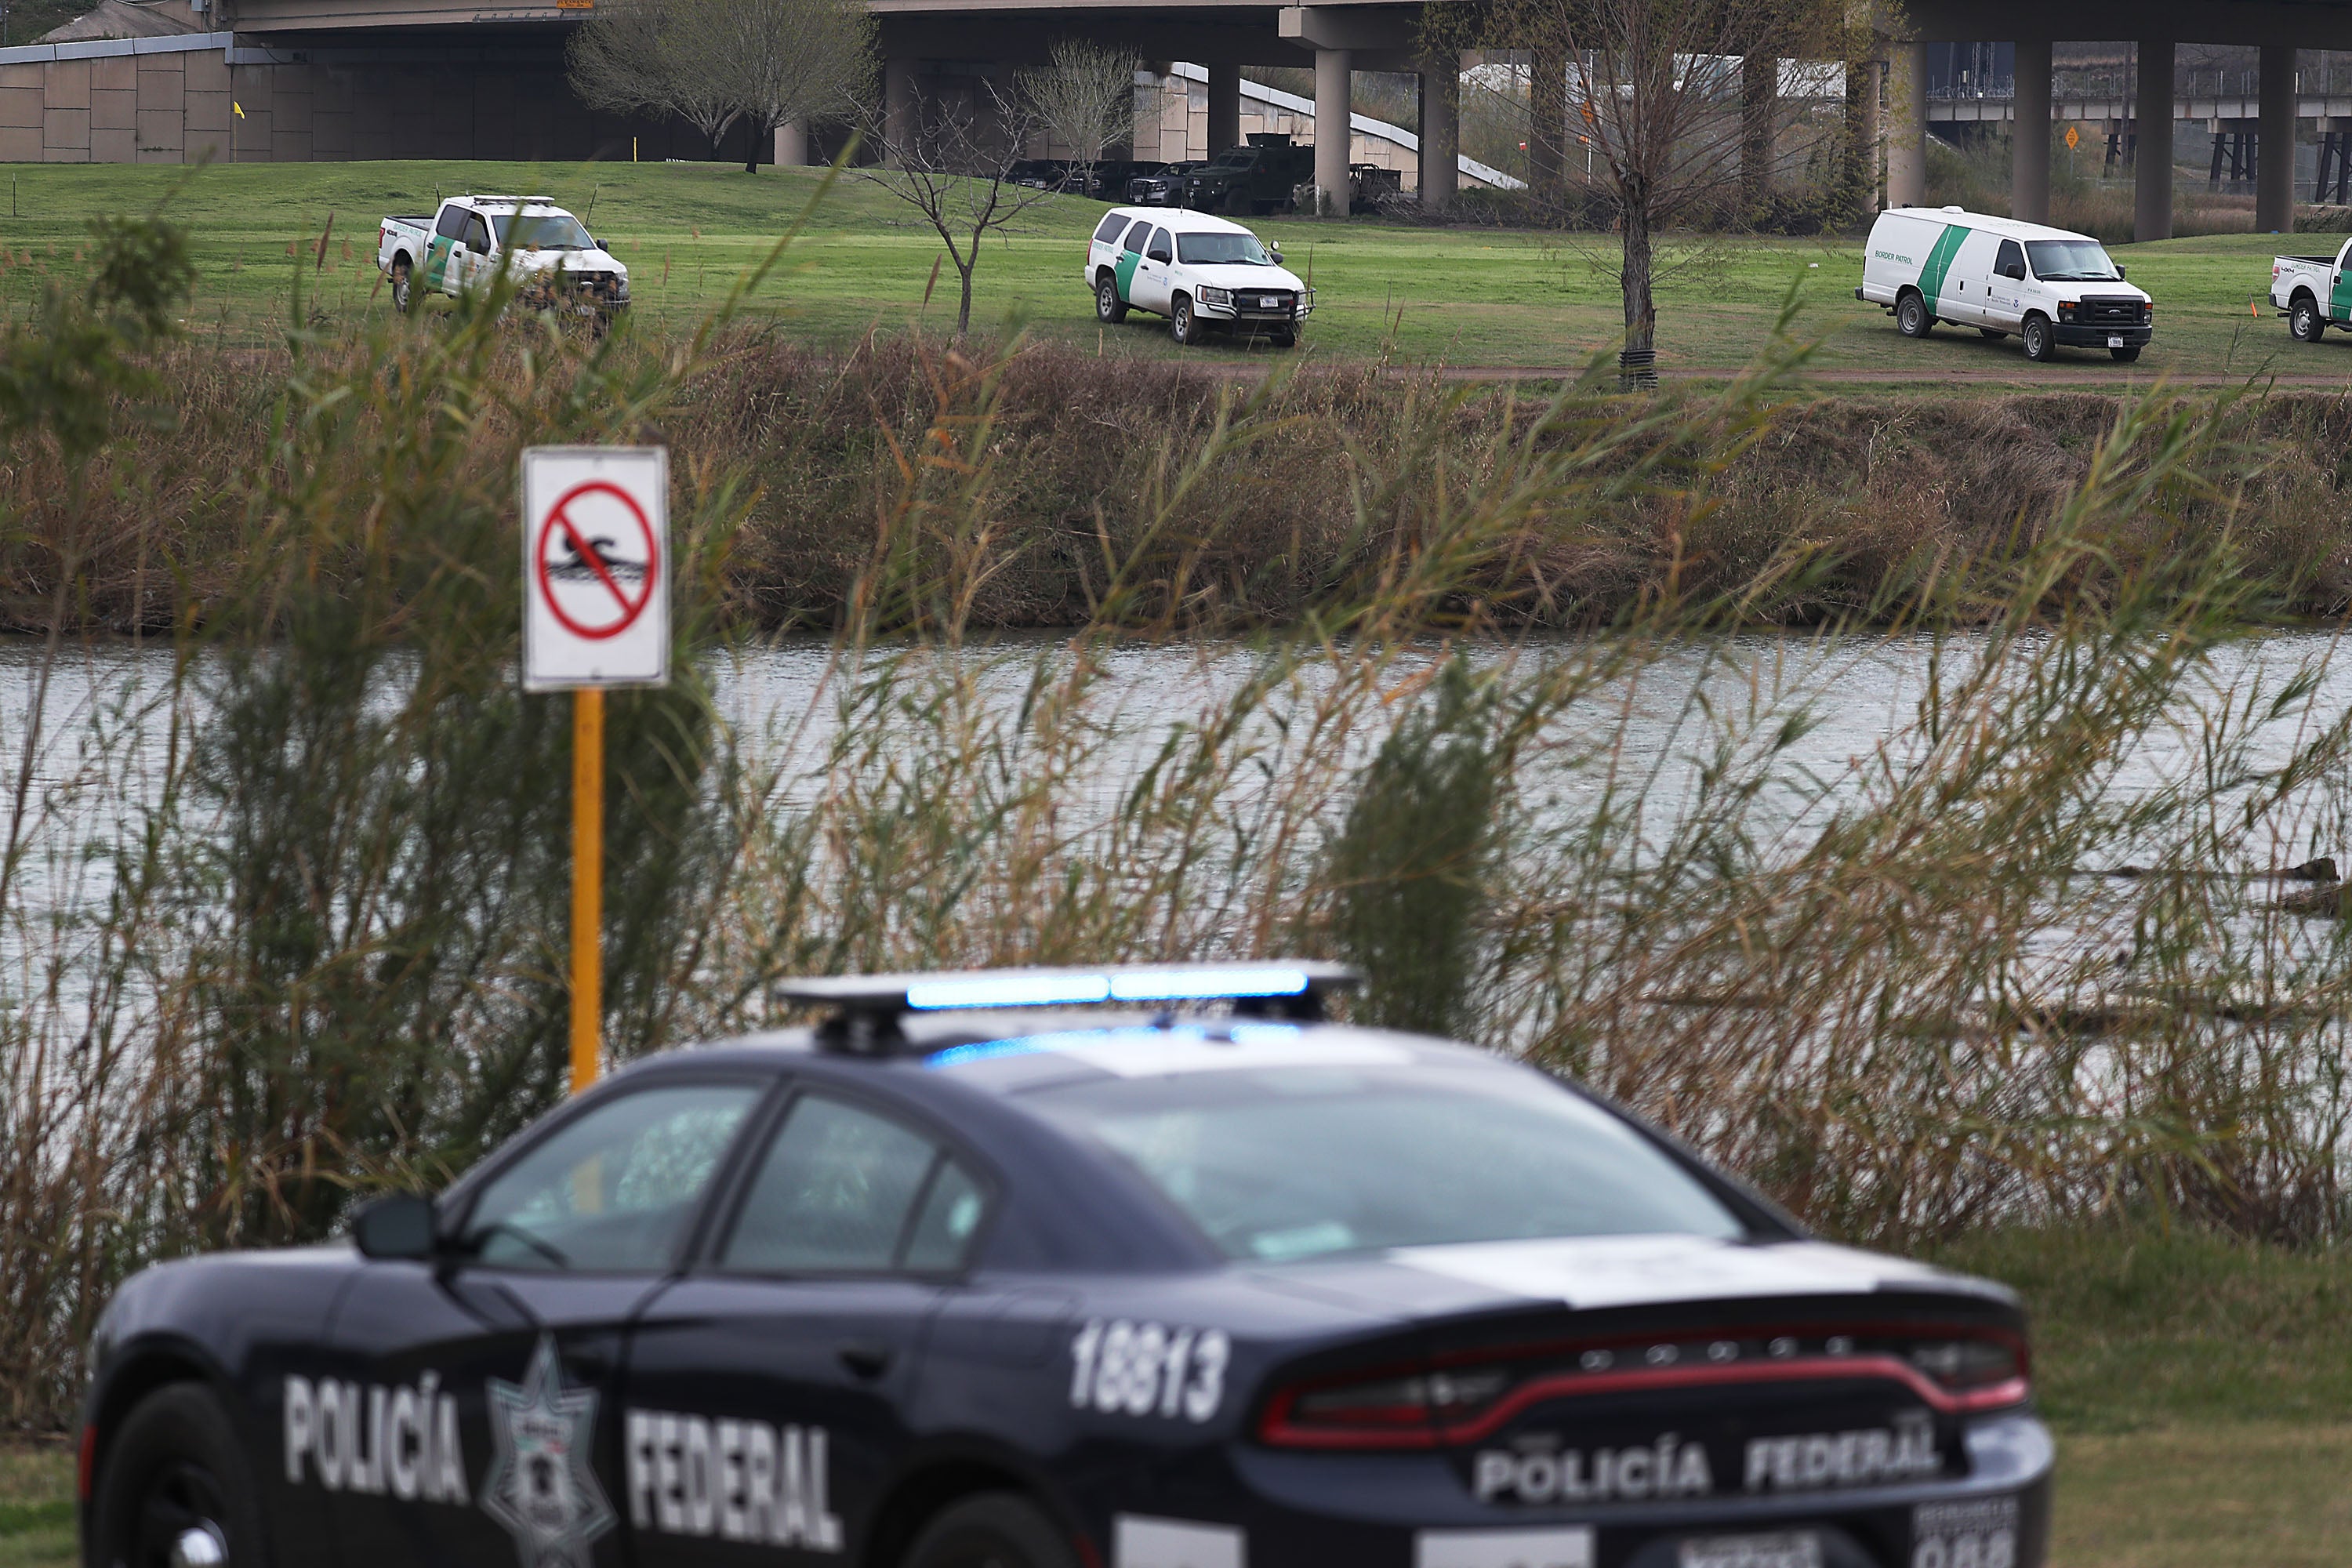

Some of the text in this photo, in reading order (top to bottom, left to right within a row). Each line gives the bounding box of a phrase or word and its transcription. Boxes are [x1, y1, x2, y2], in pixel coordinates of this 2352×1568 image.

[1875, 250, 1913, 264] BORDER PATROL
[1070, 1318, 1231, 1423] 18813
[283, 1369, 844, 1554] POLICÍA FEDERAL
[1473, 1419, 1944, 1501] POLICÍA FEDERAL
